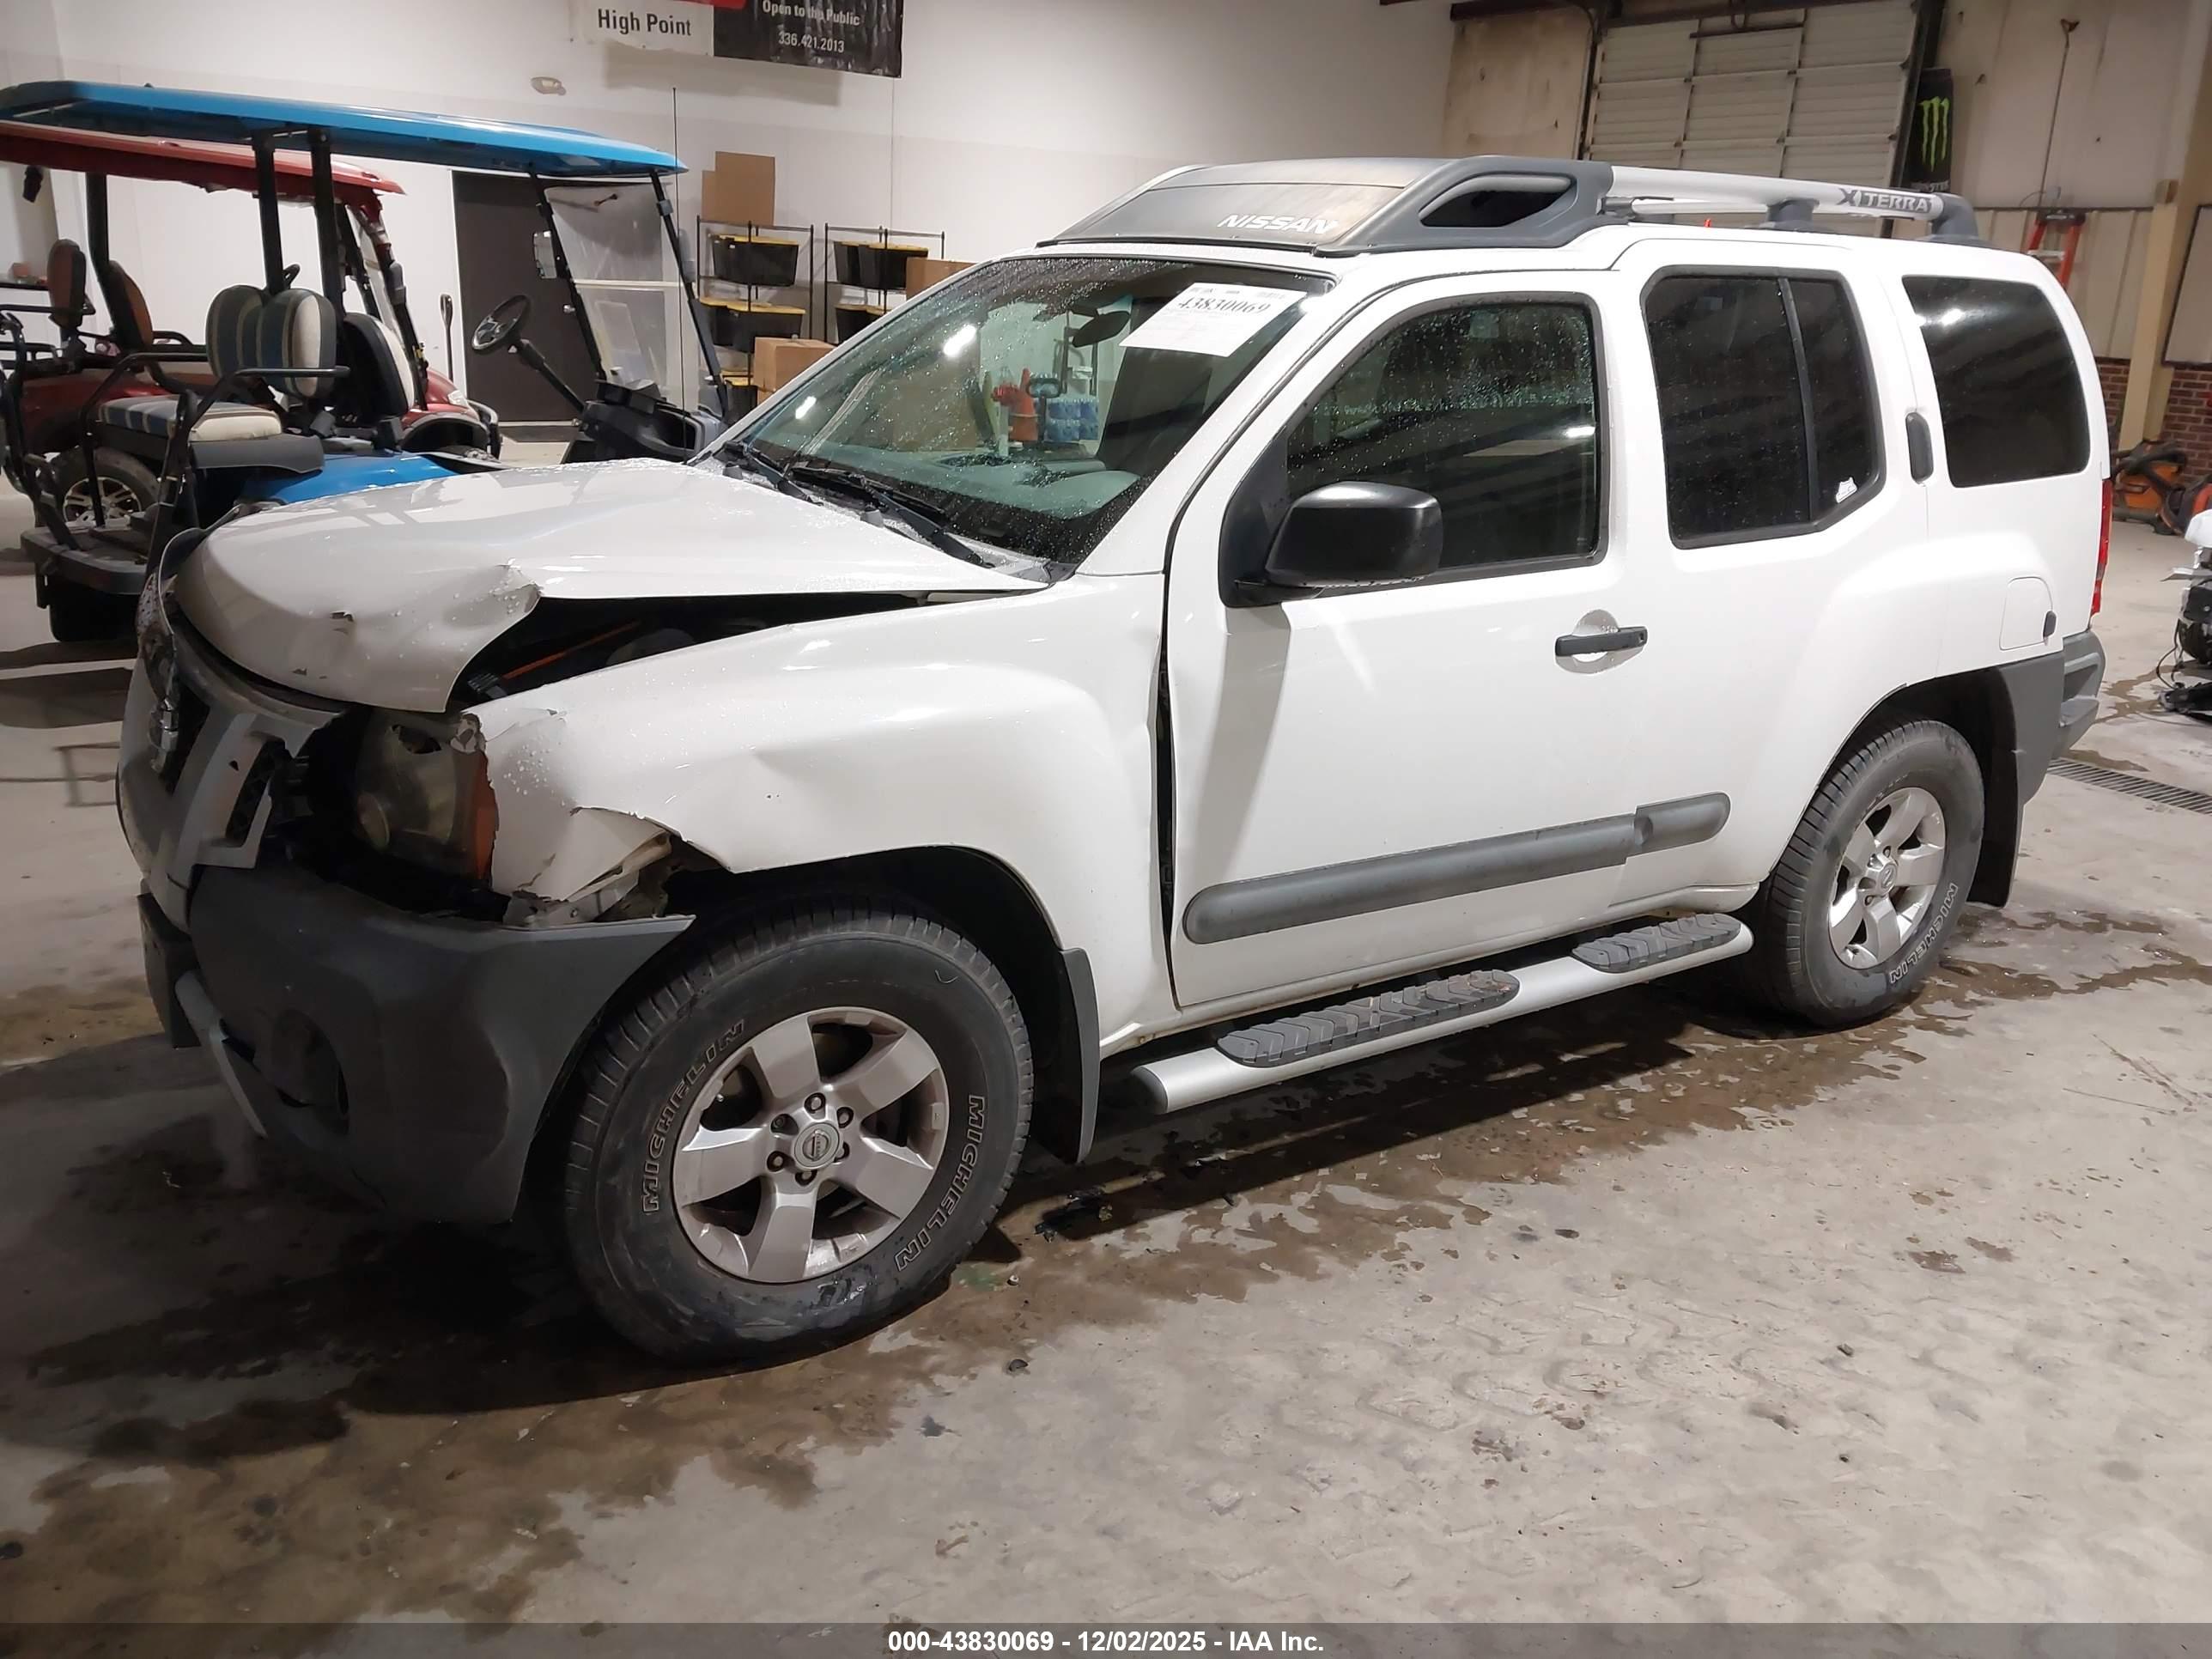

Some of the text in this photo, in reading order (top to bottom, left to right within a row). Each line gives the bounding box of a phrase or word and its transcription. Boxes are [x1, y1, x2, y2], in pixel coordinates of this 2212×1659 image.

[598, 8, 691, 36] High Point
[763, 0, 792, 16] Open
[794, 5, 805, 17] to
[826, 9, 860, 26] Public
[778, 31, 845, 53] 336.421.2013
[1836, 188, 1930, 213] XTERRA
[1217, 214, 1338, 234] NISSAN
[1178, 297, 1271, 313] 43830069
[1890, 882, 1959, 984] MICHELIN
[641, 1018, 744, 1213] MICHELIN
[896, 1094, 986, 1272] MICHELIN
